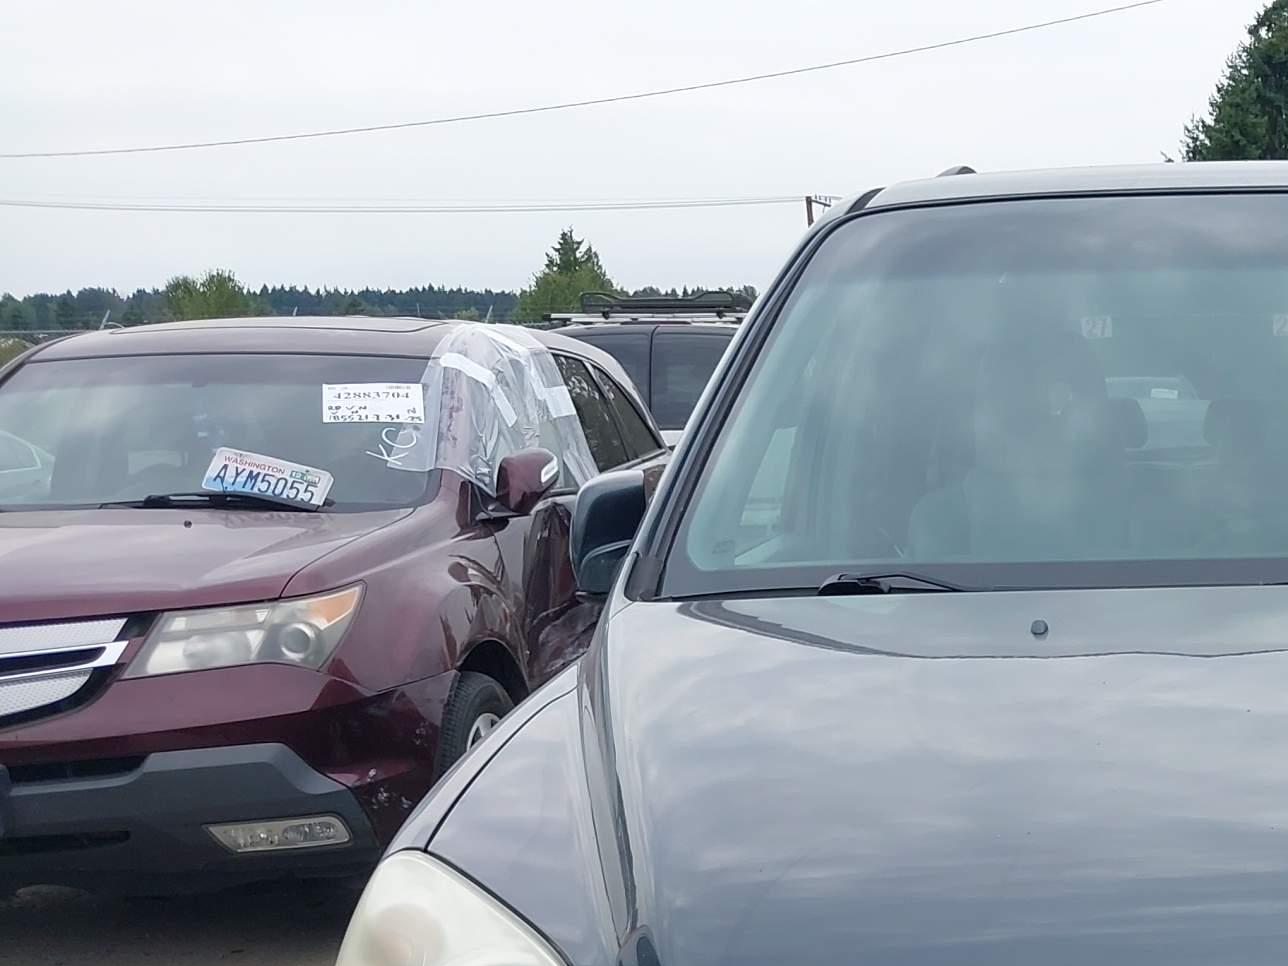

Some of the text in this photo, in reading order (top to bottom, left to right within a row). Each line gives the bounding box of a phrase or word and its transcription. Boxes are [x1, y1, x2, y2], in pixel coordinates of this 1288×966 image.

[333, 391, 410, 400] 42883704
[224, 455, 286, 475] WASHINGTON
[213, 463, 319, 504] AYM5055
